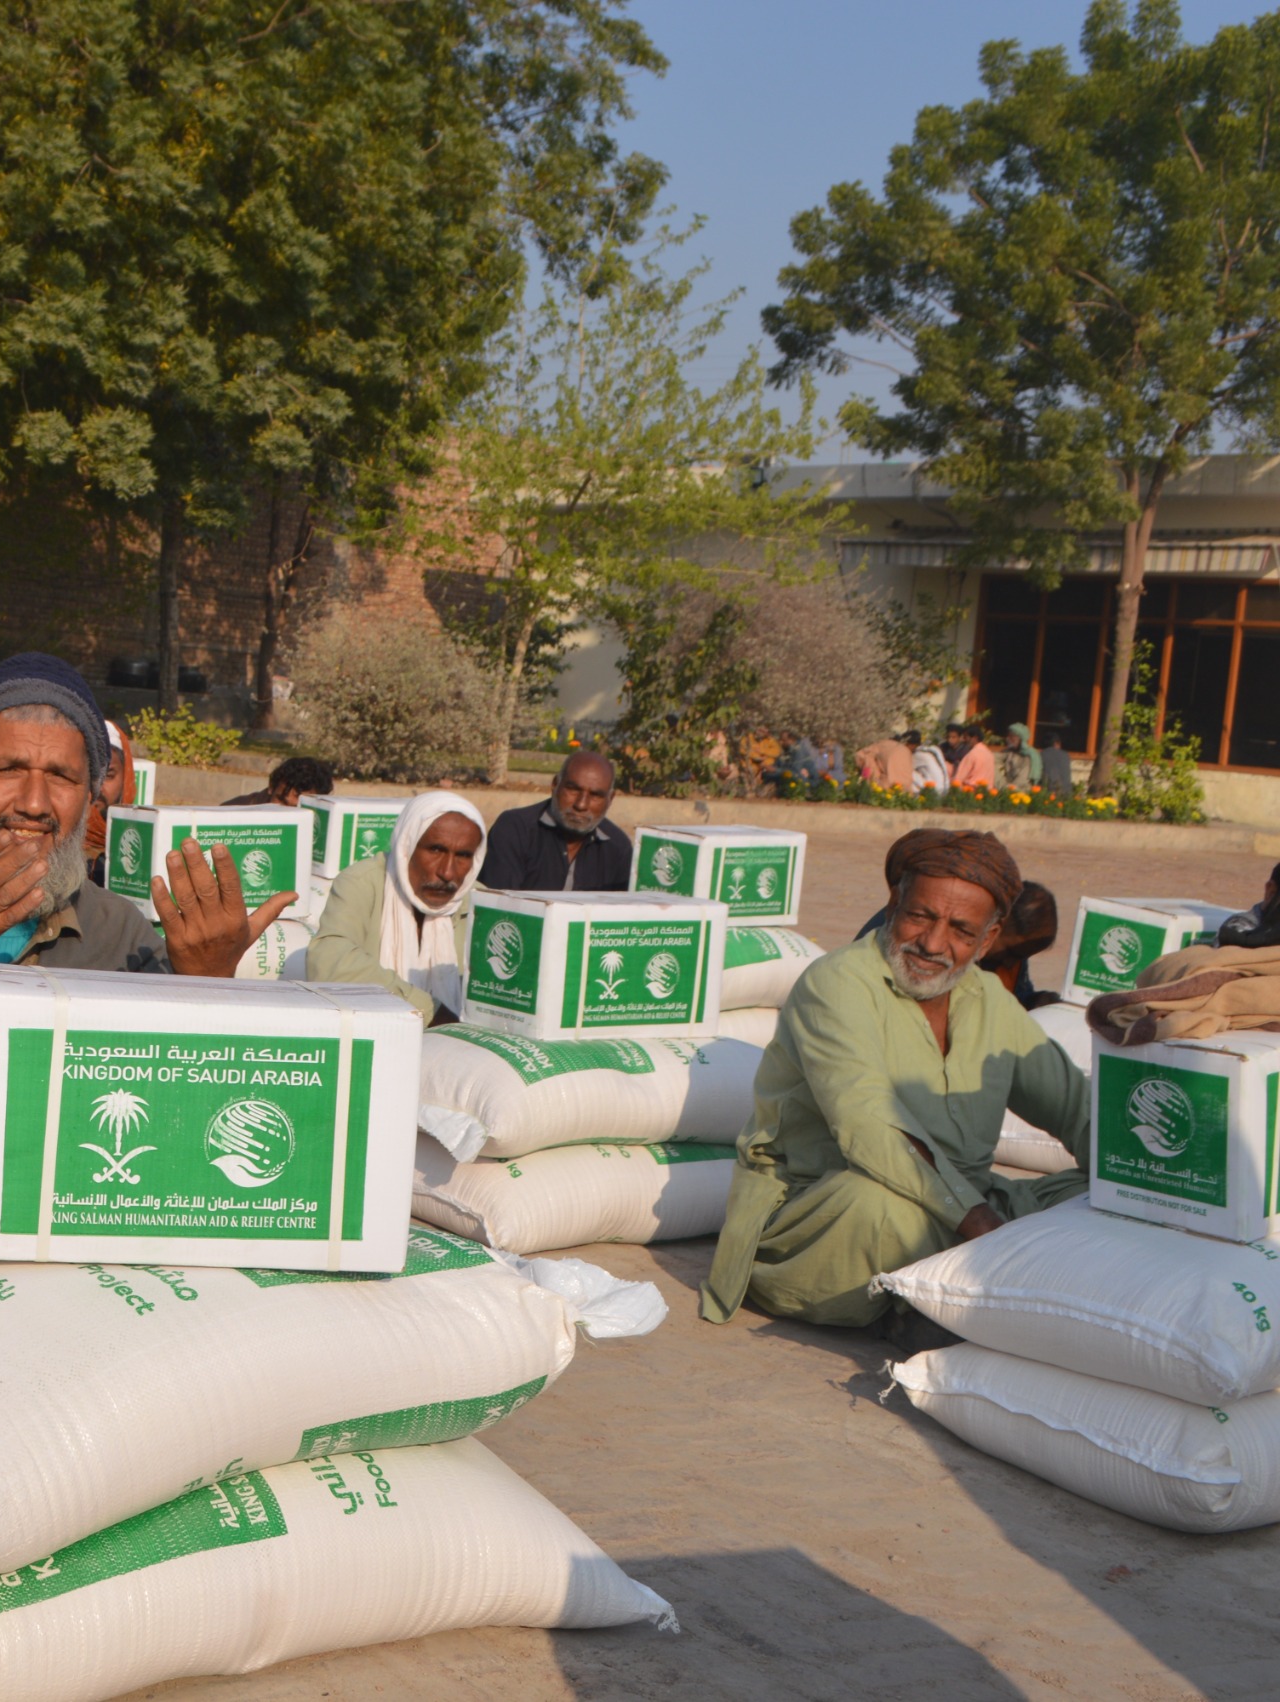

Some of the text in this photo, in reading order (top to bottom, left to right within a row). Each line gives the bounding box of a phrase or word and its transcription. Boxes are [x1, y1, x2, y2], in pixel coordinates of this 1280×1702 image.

[627, 938, 637, 946] OF
[638, 938, 662, 946] SAUDI
[663, 937, 692, 946] ARABIA
[64, 1042, 325, 1065] المملكة العربية السعودية
[62, 1064, 322, 1086] KINGDOM OF SAUDI ARABIA
[507, 1162, 523, 1178] kg
[51, 1212, 316, 1229] KING SALMAN HUMANITARIAN AID & RELIEF CENTRE
[1232, 1282, 1271, 1332] 40 kg
[352, 1452, 398, 1508] Food
